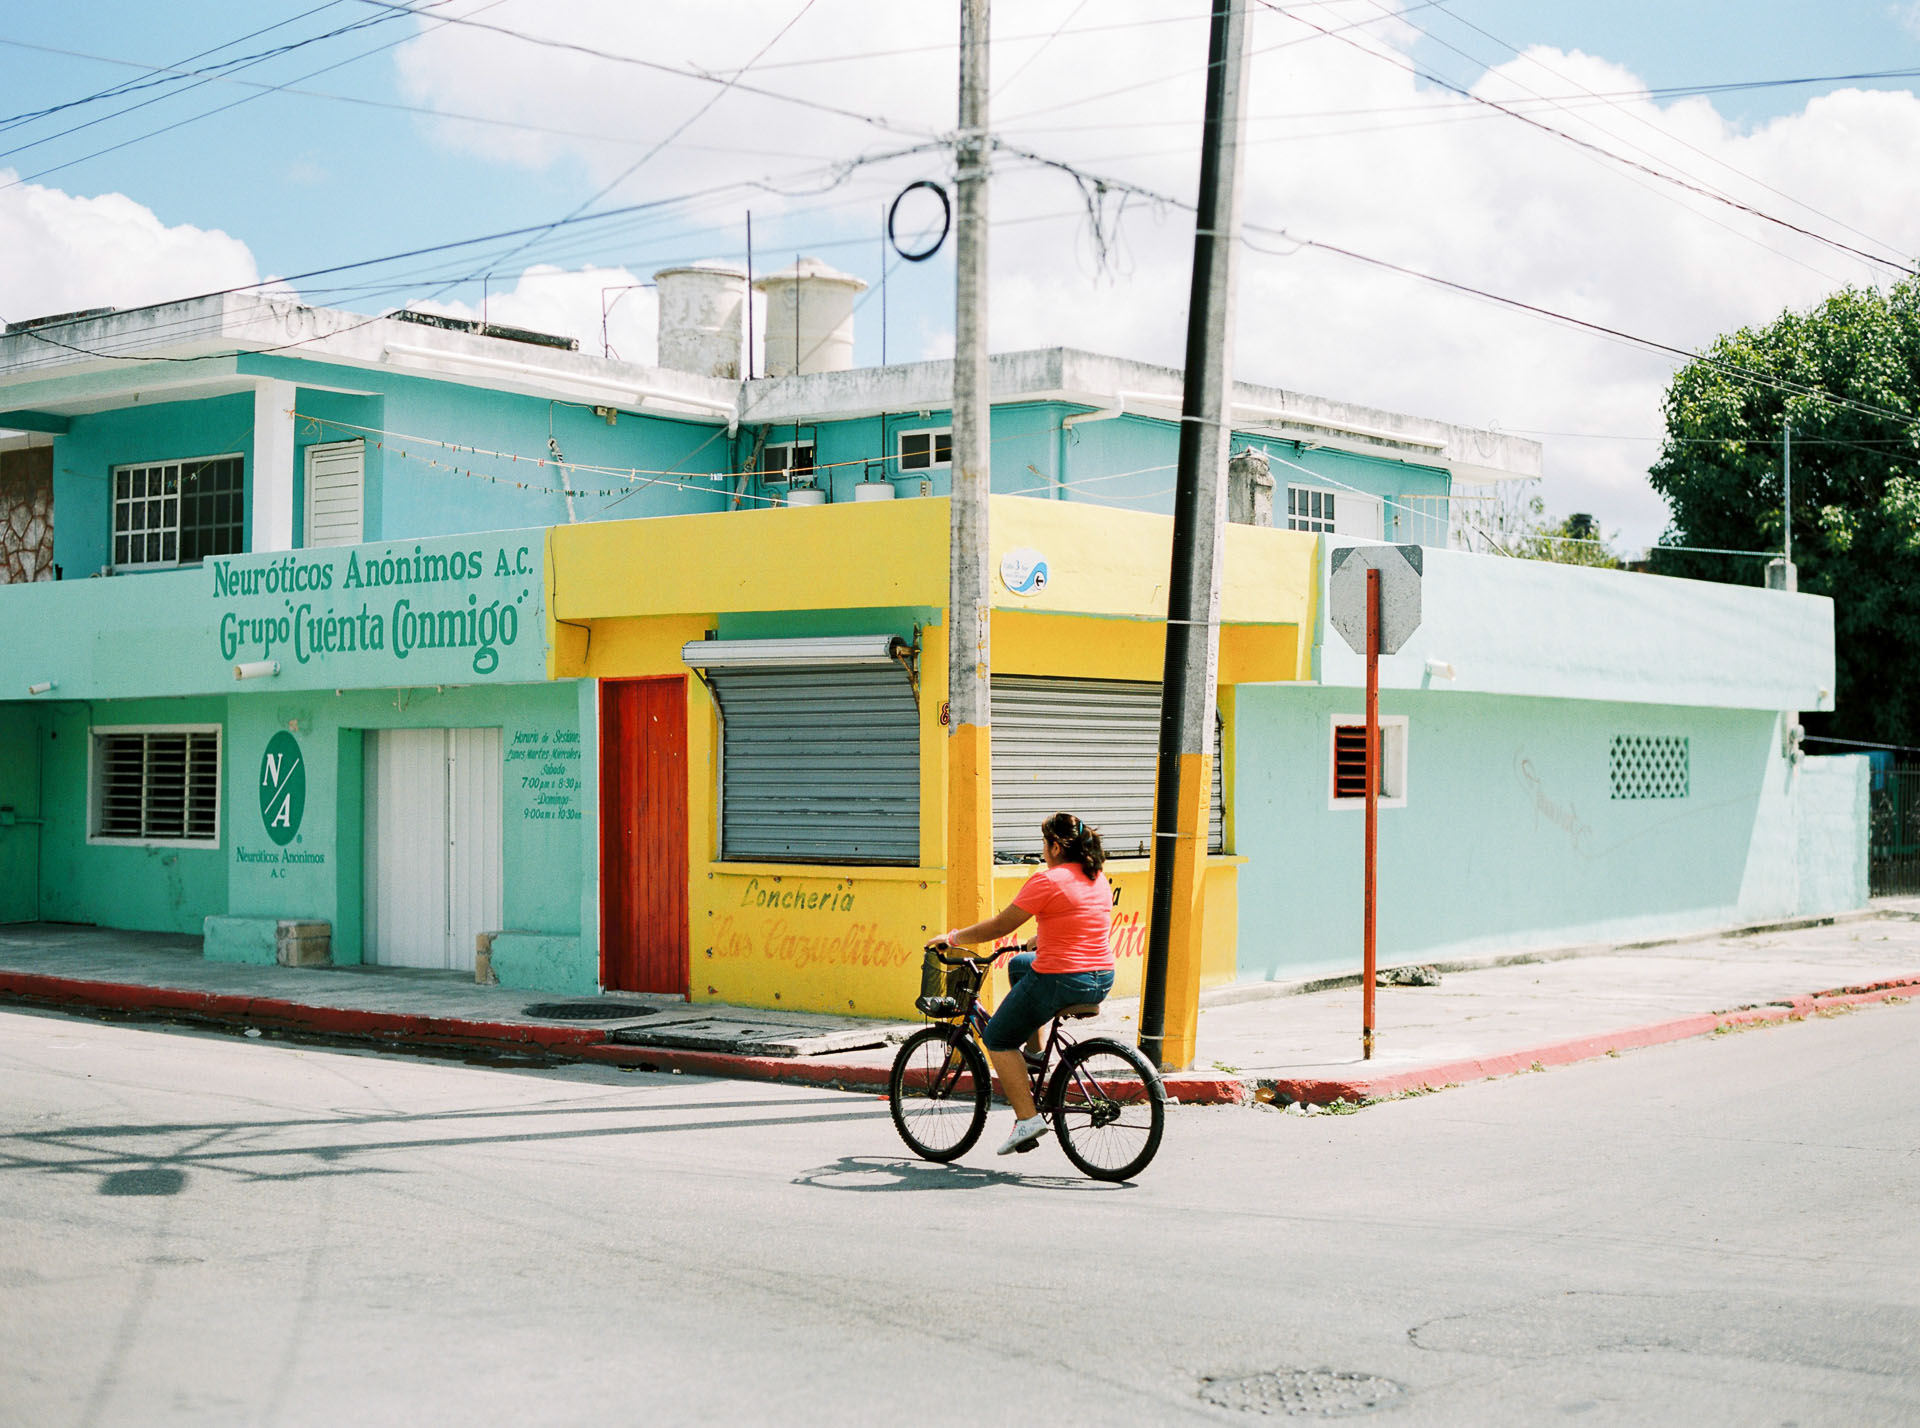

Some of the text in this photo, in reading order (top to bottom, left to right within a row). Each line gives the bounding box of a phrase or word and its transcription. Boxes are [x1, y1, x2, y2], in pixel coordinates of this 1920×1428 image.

[213, 546, 534, 598] Neuróticos Anónimos A.C.
[220, 611, 290, 662] Grupo
